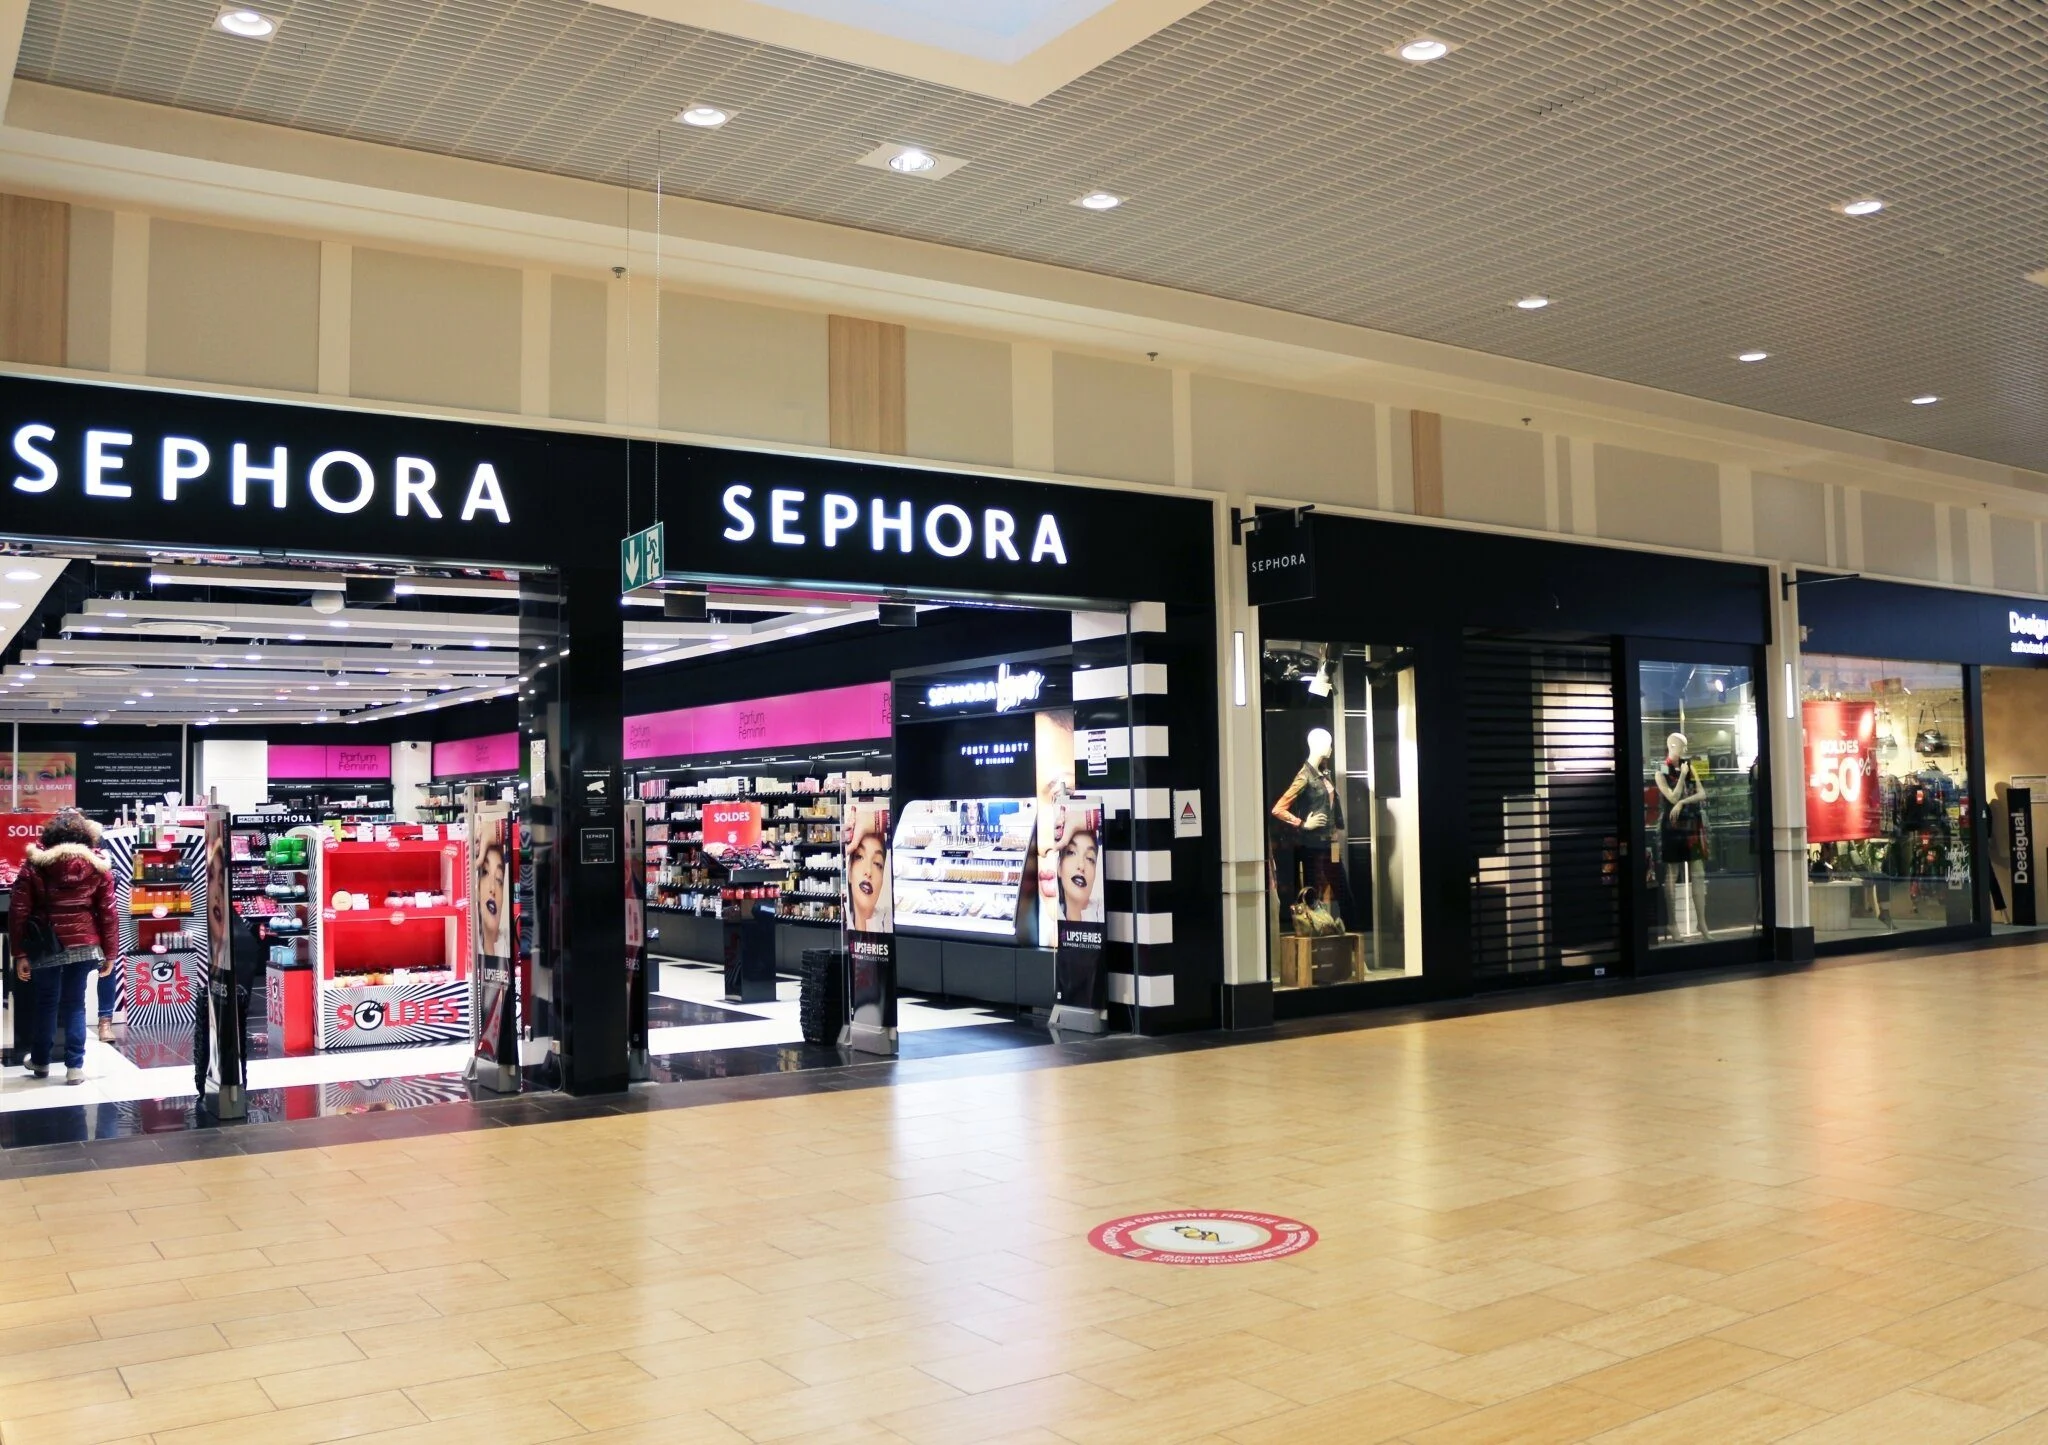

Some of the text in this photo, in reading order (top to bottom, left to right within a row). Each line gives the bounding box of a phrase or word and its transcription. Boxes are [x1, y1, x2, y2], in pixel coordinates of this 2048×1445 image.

[13, 424, 511, 524] SEPHORA
[722, 484, 1069, 565] SEPHORA
[1252, 554, 1306, 573] SEPHORA
[739, 710, 765, 725] Parfum
[630, 725, 650, 737] Parfum
[962, 743, 1029, 756] FENTY BEAUTY
[1820, 739, 1859, 754] SOLDES
[340, 752, 377, 762] Parfum
[975, 758, 983, 766] BY
[46, 783, 73, 791] BEAUTÉ
[265, 815, 312, 823] SEPHORA
[714, 811, 750, 823] SOLDES
[2011, 812, 2028, 884] Desigual
[136, 982, 190, 1006] DES
[336, 998, 460, 1031] SOLDES
[1134, 1212, 1217, 1223] CHALLENGE
